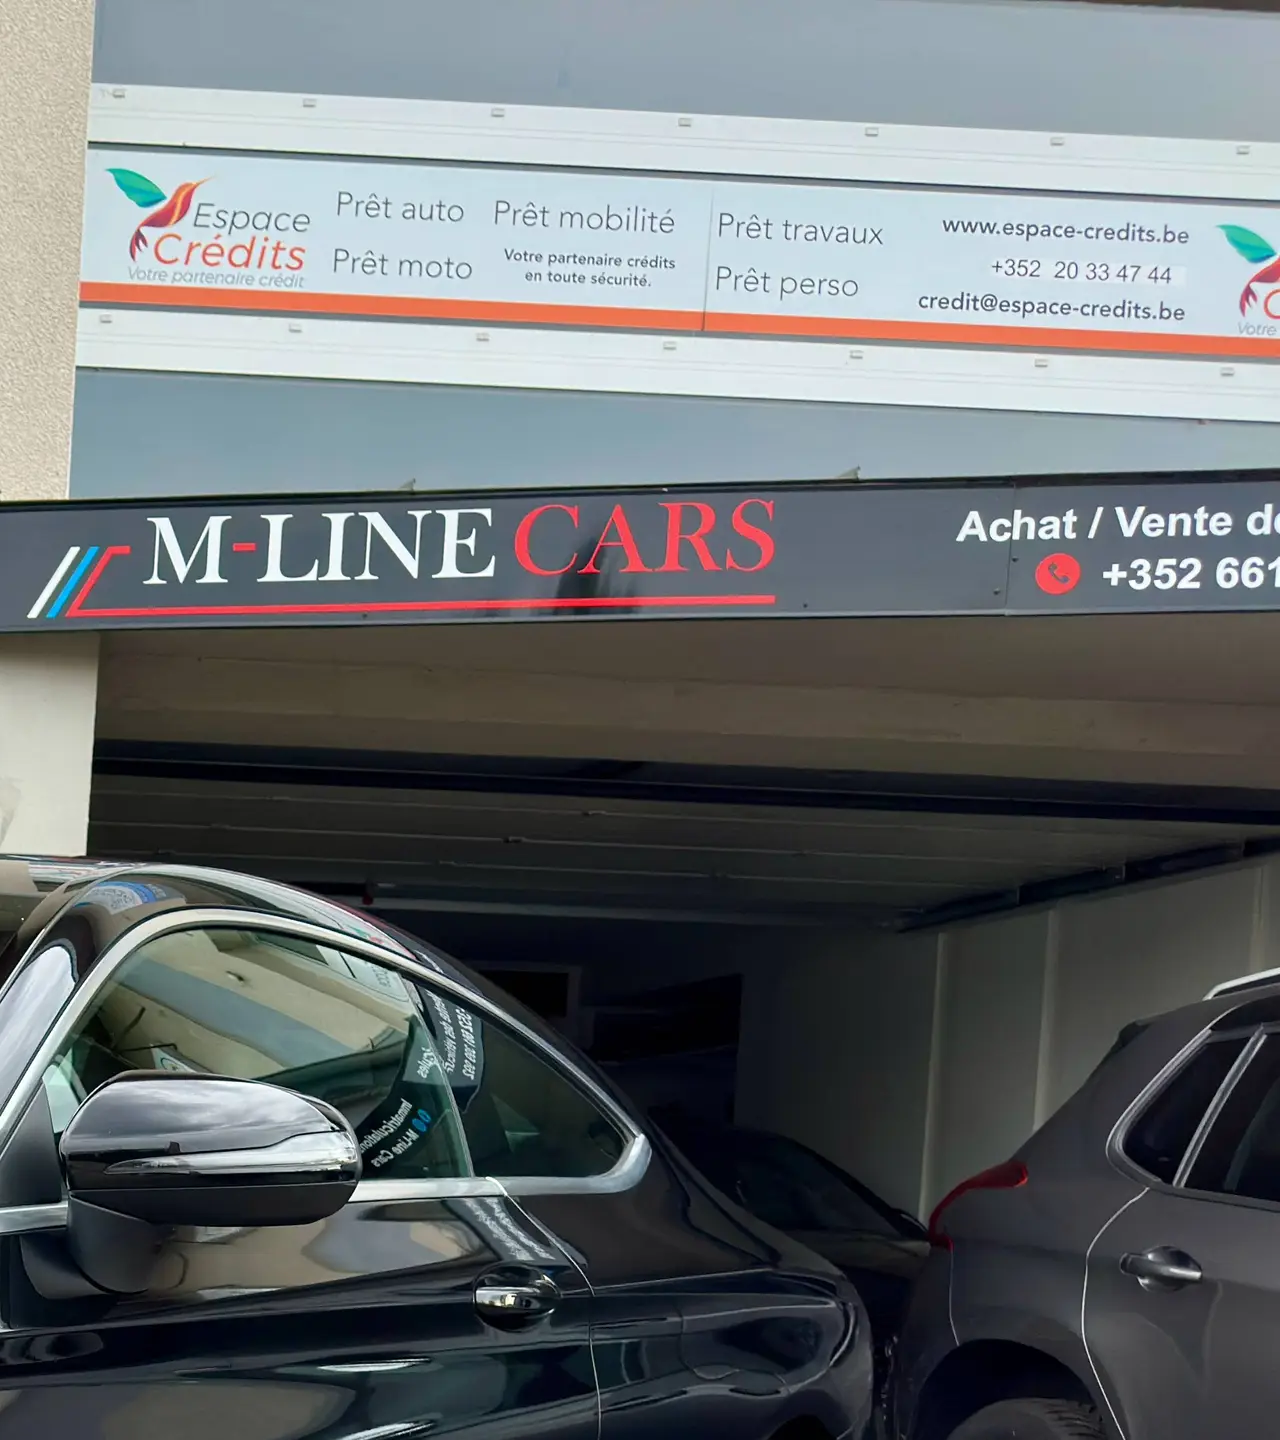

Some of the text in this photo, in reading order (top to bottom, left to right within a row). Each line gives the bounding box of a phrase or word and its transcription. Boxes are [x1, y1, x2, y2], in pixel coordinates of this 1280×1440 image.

[193, 202, 311, 236] Espace
[336, 191, 465, 224] Prêt auto
[493, 200, 675, 234] Prêt mobilité
[717, 212, 885, 247] Prêt travaux
[942, 219, 1190, 244] www.espace-credits.be
[154, 233, 306, 271] Crédits
[332, 247, 473, 281] Prêt moto
[504, 248, 676, 269] Votre partenaire crédits
[127, 266, 306, 288] Votre partenaire crédit
[524, 271, 652, 287] en toute sécurité.
[715, 265, 860, 301] Prêt perso
[992, 258, 1172, 284] +352 20 33 47 44
[918, 292, 1186, 321] credit@espace-credits.be
[1237, 322, 1278, 337] Votre
[956, 503, 1280, 543] Achat / Vente d
[143, 498, 777, 586] M-LINE CARS
[1103, 558, 1202, 590] +352
